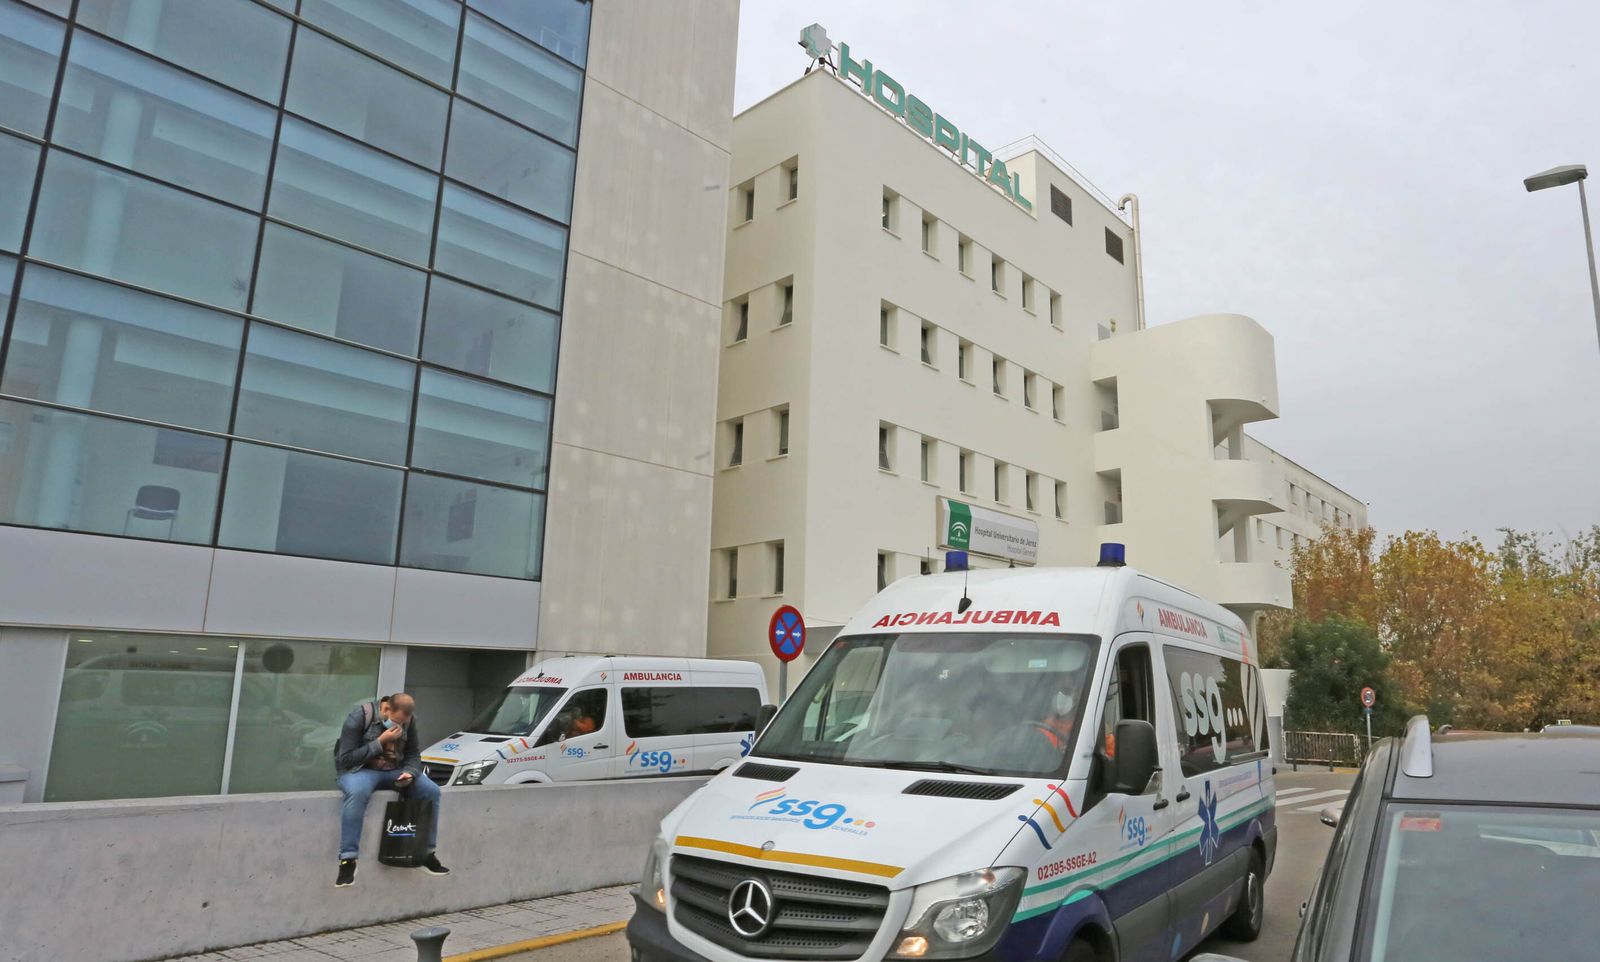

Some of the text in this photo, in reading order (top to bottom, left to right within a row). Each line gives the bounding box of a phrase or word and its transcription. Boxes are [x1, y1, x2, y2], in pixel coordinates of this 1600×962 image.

[837, 41, 1032, 210] HOSPITAL
[974, 526, 1037, 548] Hospital Universitario de Jerez
[1158, 608, 1207, 639] AMBULANCIA
[623, 672, 682, 681] AMBULANCIA
[1037, 851, 1097, 881] 02395-SSGE-A2
